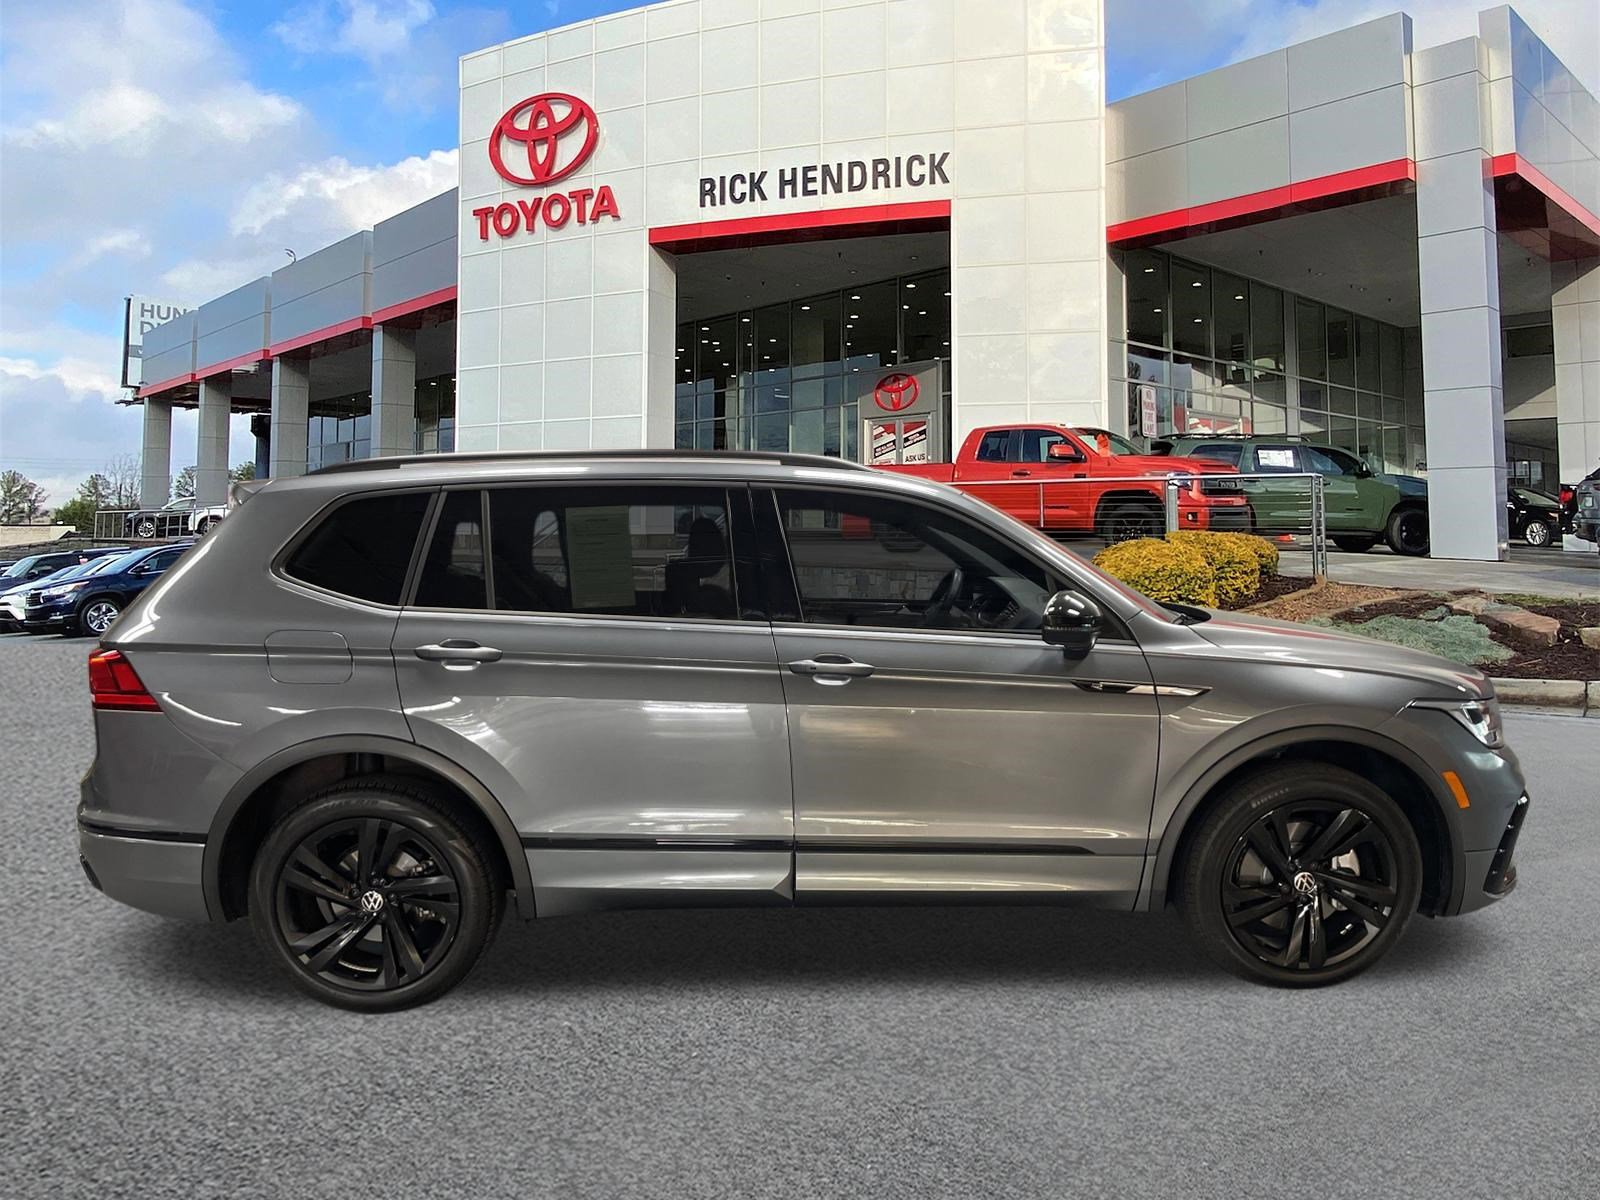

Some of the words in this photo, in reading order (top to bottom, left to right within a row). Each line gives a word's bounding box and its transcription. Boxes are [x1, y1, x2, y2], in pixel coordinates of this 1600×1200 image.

[699, 171, 768, 208] RICK
[778, 151, 951, 200] HENDRICK
[472, 185, 621, 240] TOYOTA
